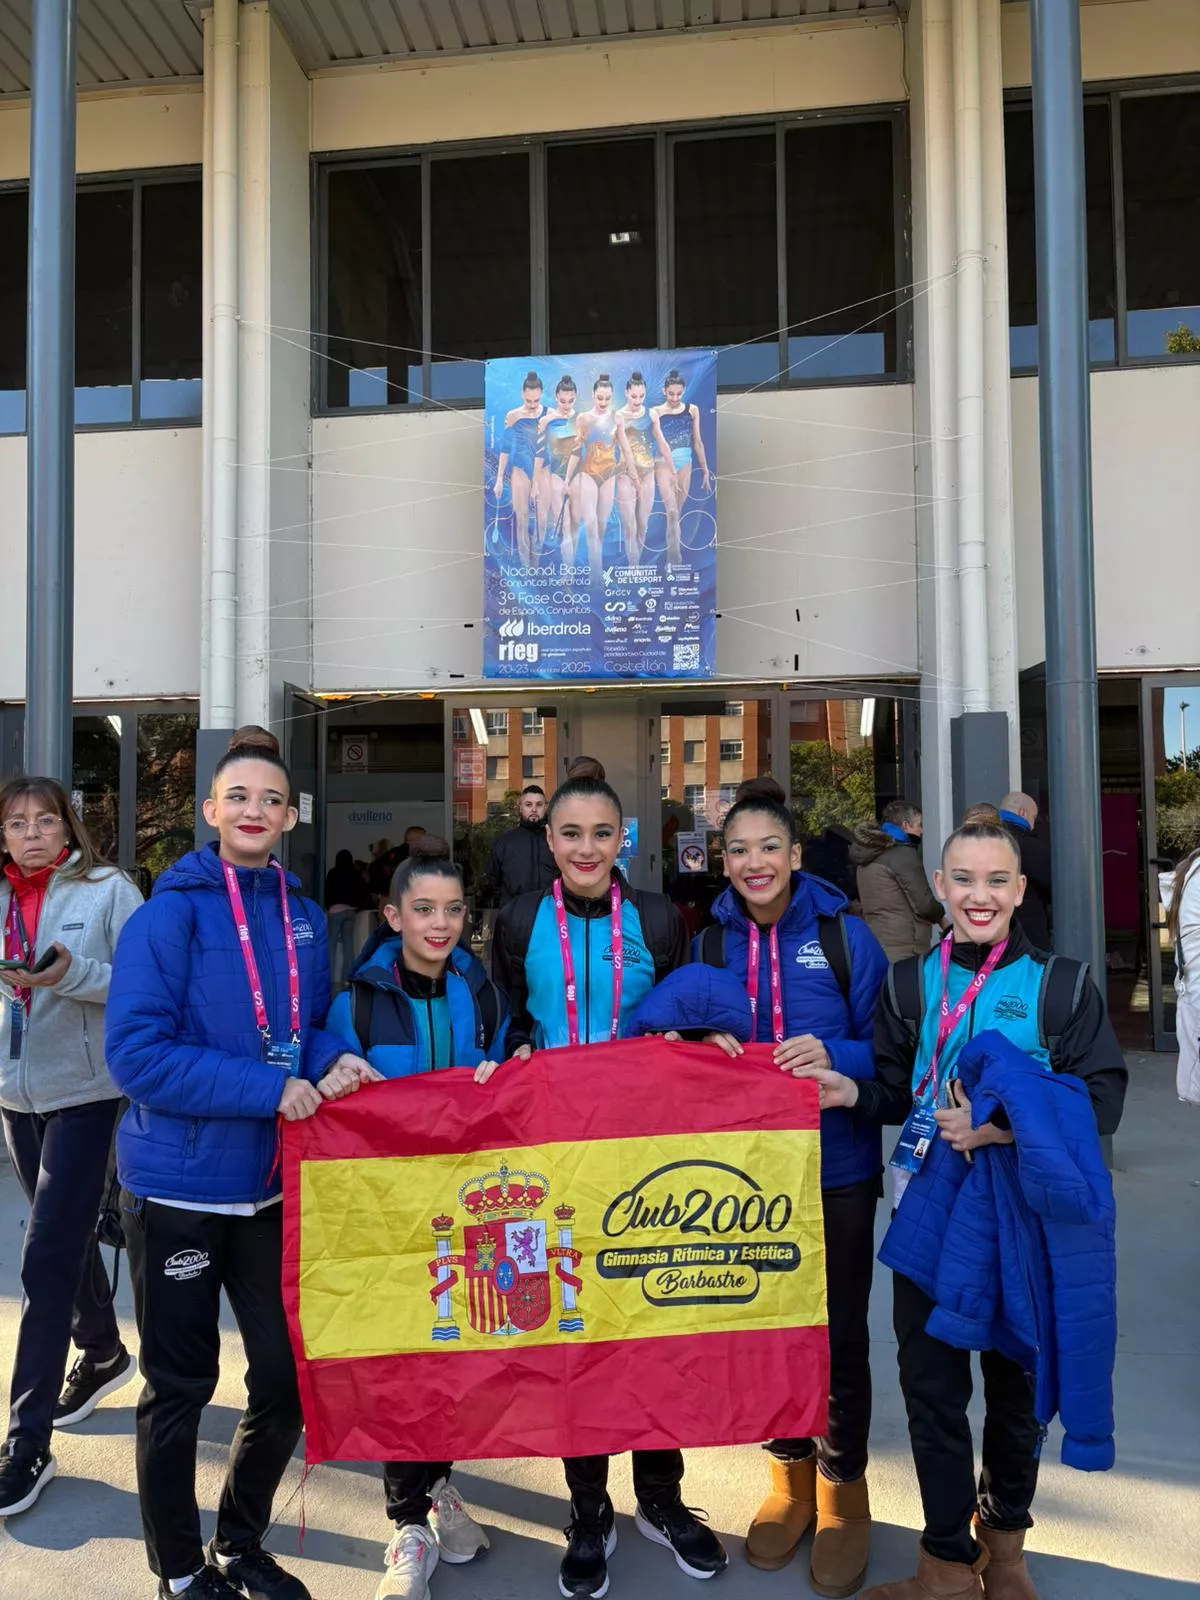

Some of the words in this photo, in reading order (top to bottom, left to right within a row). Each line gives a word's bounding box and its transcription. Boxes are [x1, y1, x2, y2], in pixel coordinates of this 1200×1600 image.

[500, 562, 556, 576] Nacional
[560, 563, 591, 576] Base
[500, 579, 547, 588] Conjuntos
[518, 591, 550, 605] Fase
[552, 591, 591, 606] Copa
[499, 607, 511, 615] de
[527, 621, 591, 636] Iberdrola
[499, 640, 538, 662] rfeg
[561, 661, 592, 673] 2025
[604, 660, 667, 672] Castellón
[602, 1188, 793, 1237] Club2000
[550, 1249, 579, 1260] VLTRA
[603, 1252, 668, 1267] Gimnasia
[672, 1247, 725, 1262] Rítmica
[729, 1249, 738, 1264] y
[741, 1246, 793, 1260] Estética
[656, 1269, 748, 1295] Barbastro
